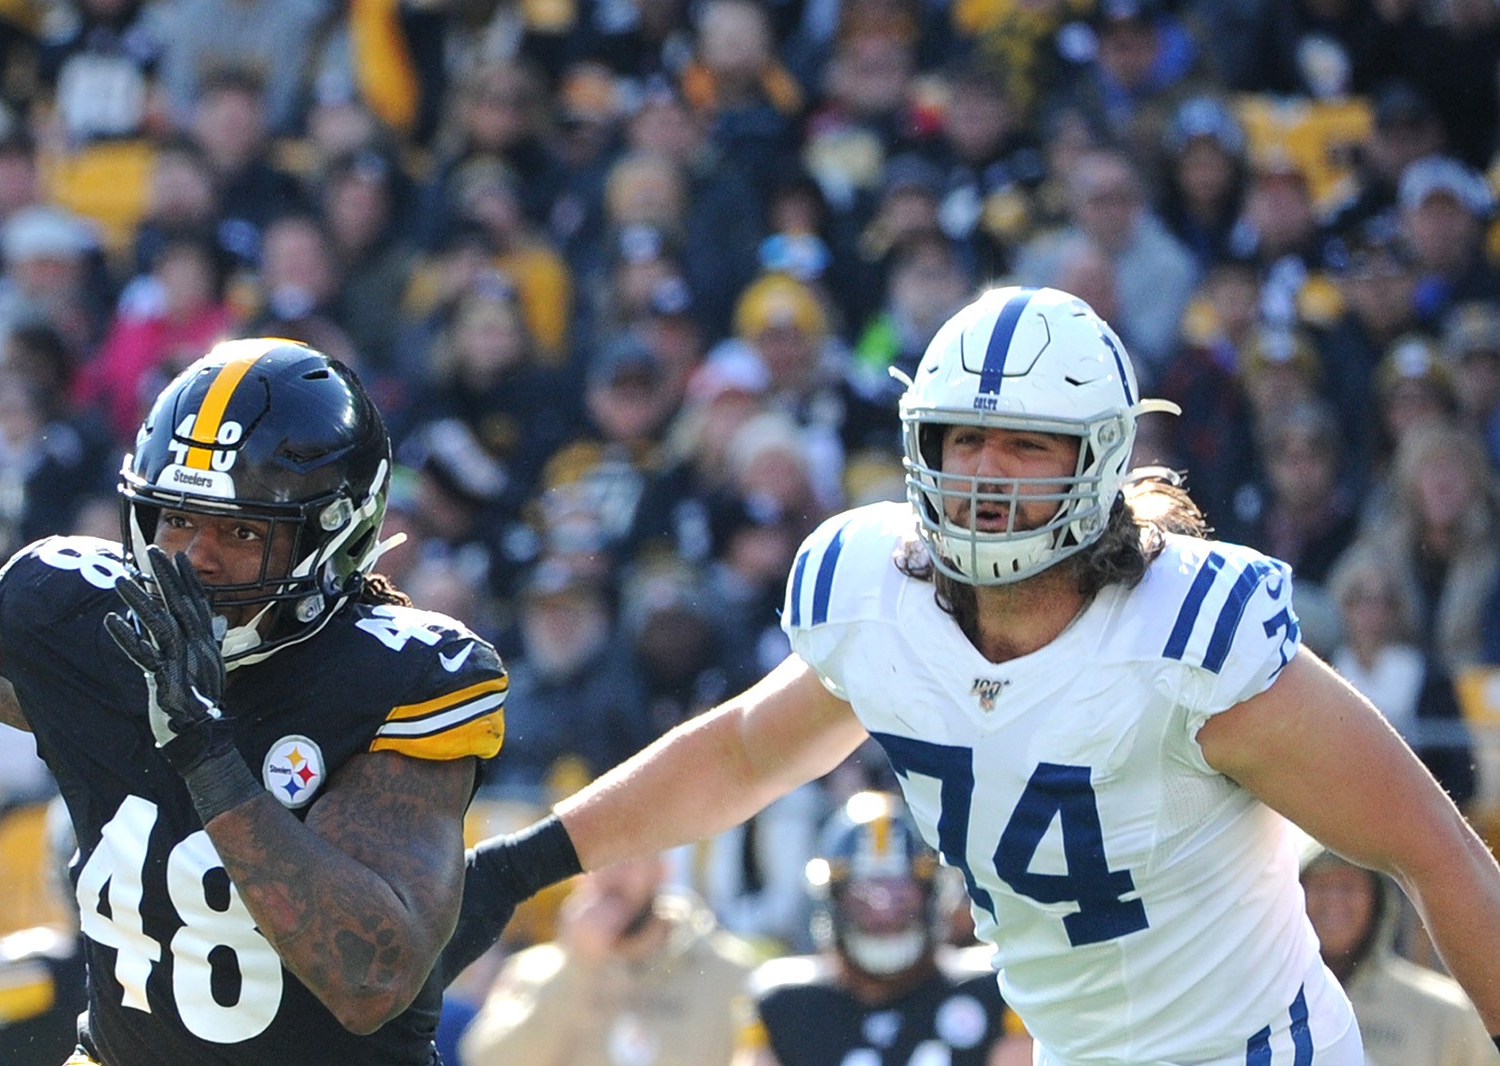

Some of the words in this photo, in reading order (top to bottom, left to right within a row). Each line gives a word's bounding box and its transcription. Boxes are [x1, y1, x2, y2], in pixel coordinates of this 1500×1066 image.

[168, 413, 243, 472] 48
[173, 469, 213, 488] Steelers
[869, 731, 1149, 947] 74
[76, 794, 283, 1044] 48
